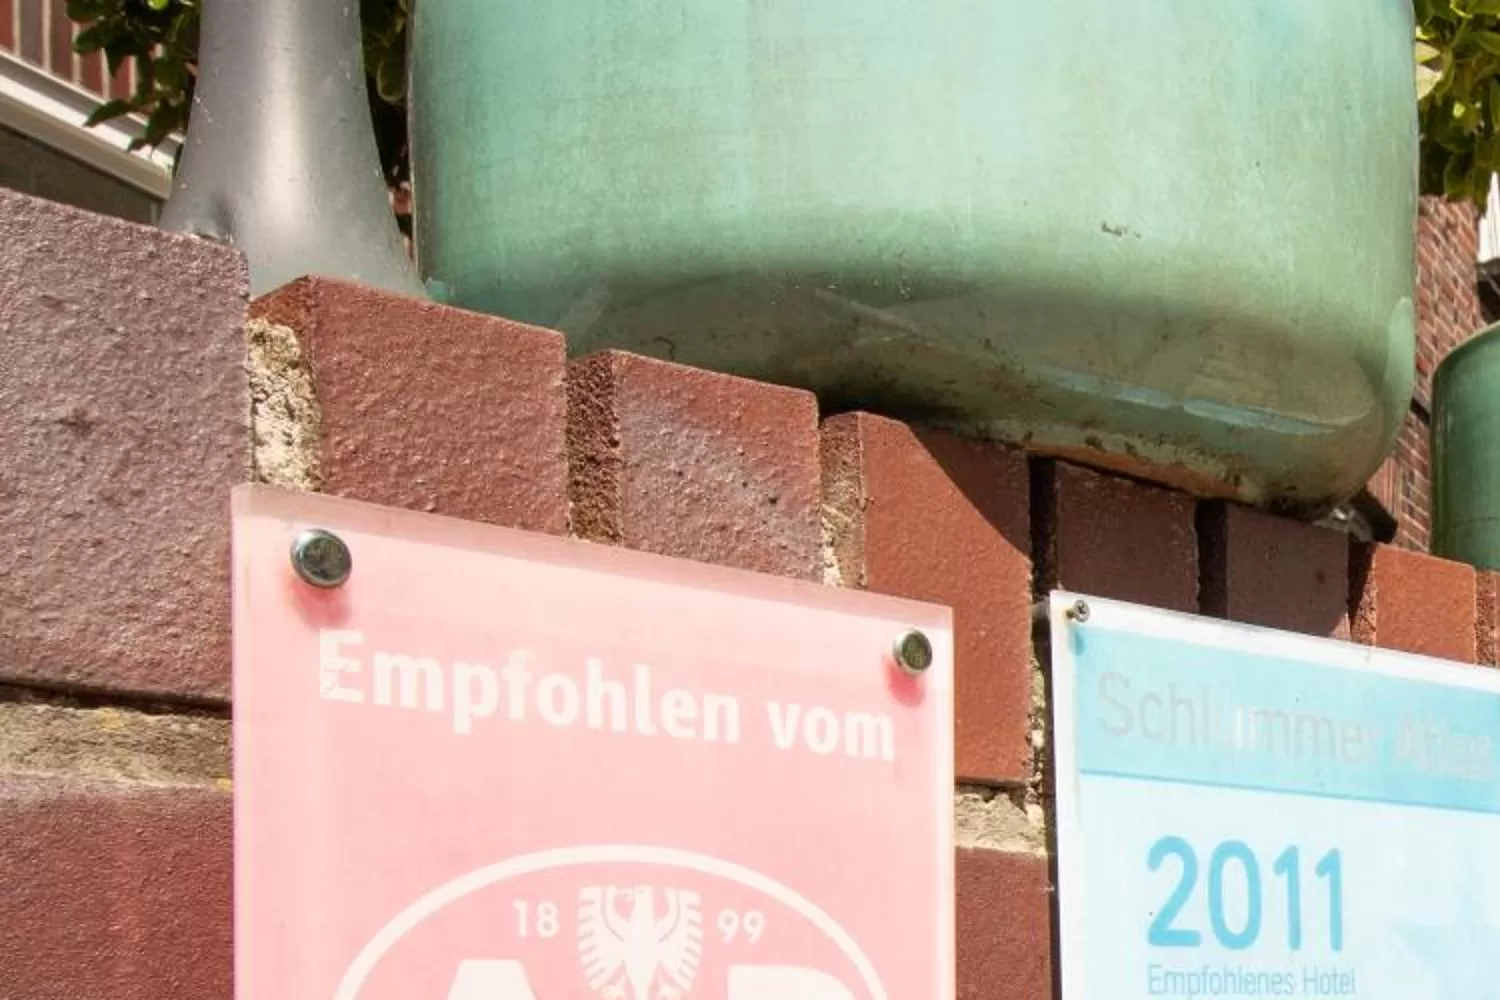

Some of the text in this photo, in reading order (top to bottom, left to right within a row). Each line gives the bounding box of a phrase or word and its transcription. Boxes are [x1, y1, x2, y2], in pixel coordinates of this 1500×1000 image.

[318, 628, 895, 761] Empfohlen vom
[512, 898, 766, 945] 18 99
[1147, 835, 1343, 952] 2011
[1147, 963, 1356, 1000] Empfohlenes Hotel
